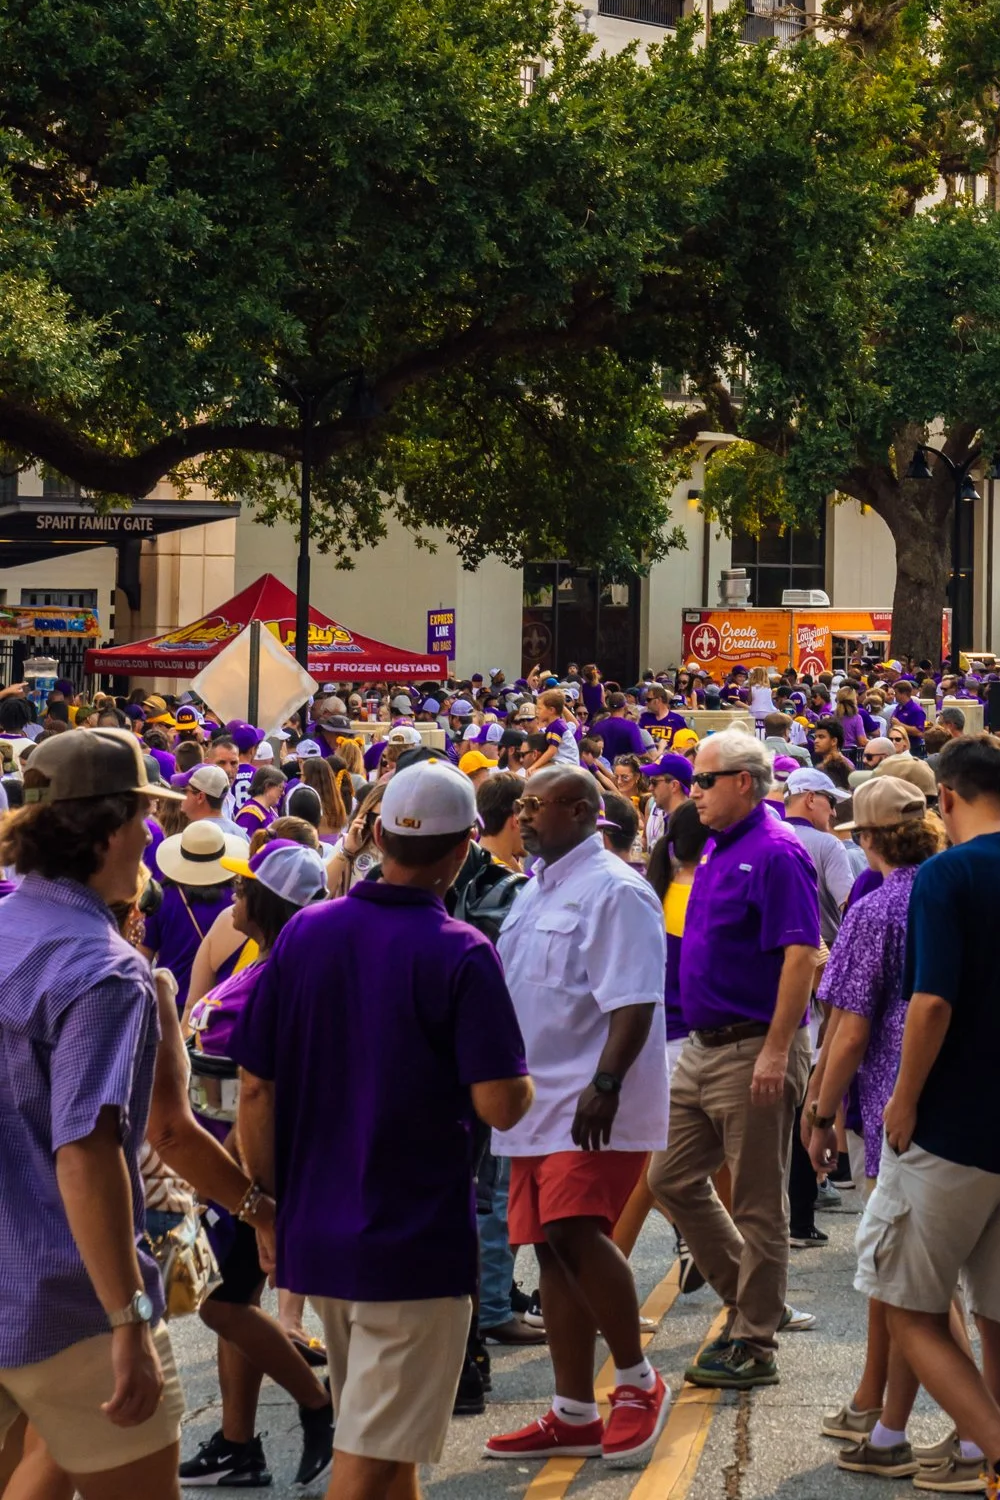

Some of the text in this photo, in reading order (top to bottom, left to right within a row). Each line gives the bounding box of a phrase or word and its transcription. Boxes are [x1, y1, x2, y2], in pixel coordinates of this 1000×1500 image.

[36, 515, 154, 531] SPAHT FAMILY GATE
[430, 613, 453, 625] EXPRESS
[435, 626, 449, 637] LANE
[720, 621, 758, 637] Creole
[796, 626, 830, 644] Louisiana
[722, 637, 778, 652] Creations
[153, 660, 183, 669] FOLLOW
[185, 661, 196, 669] US
[307, 663, 441, 672] EST FROZEN CUSTARD
[651, 727, 673, 742] SU
[395, 816, 422, 830] LSU
